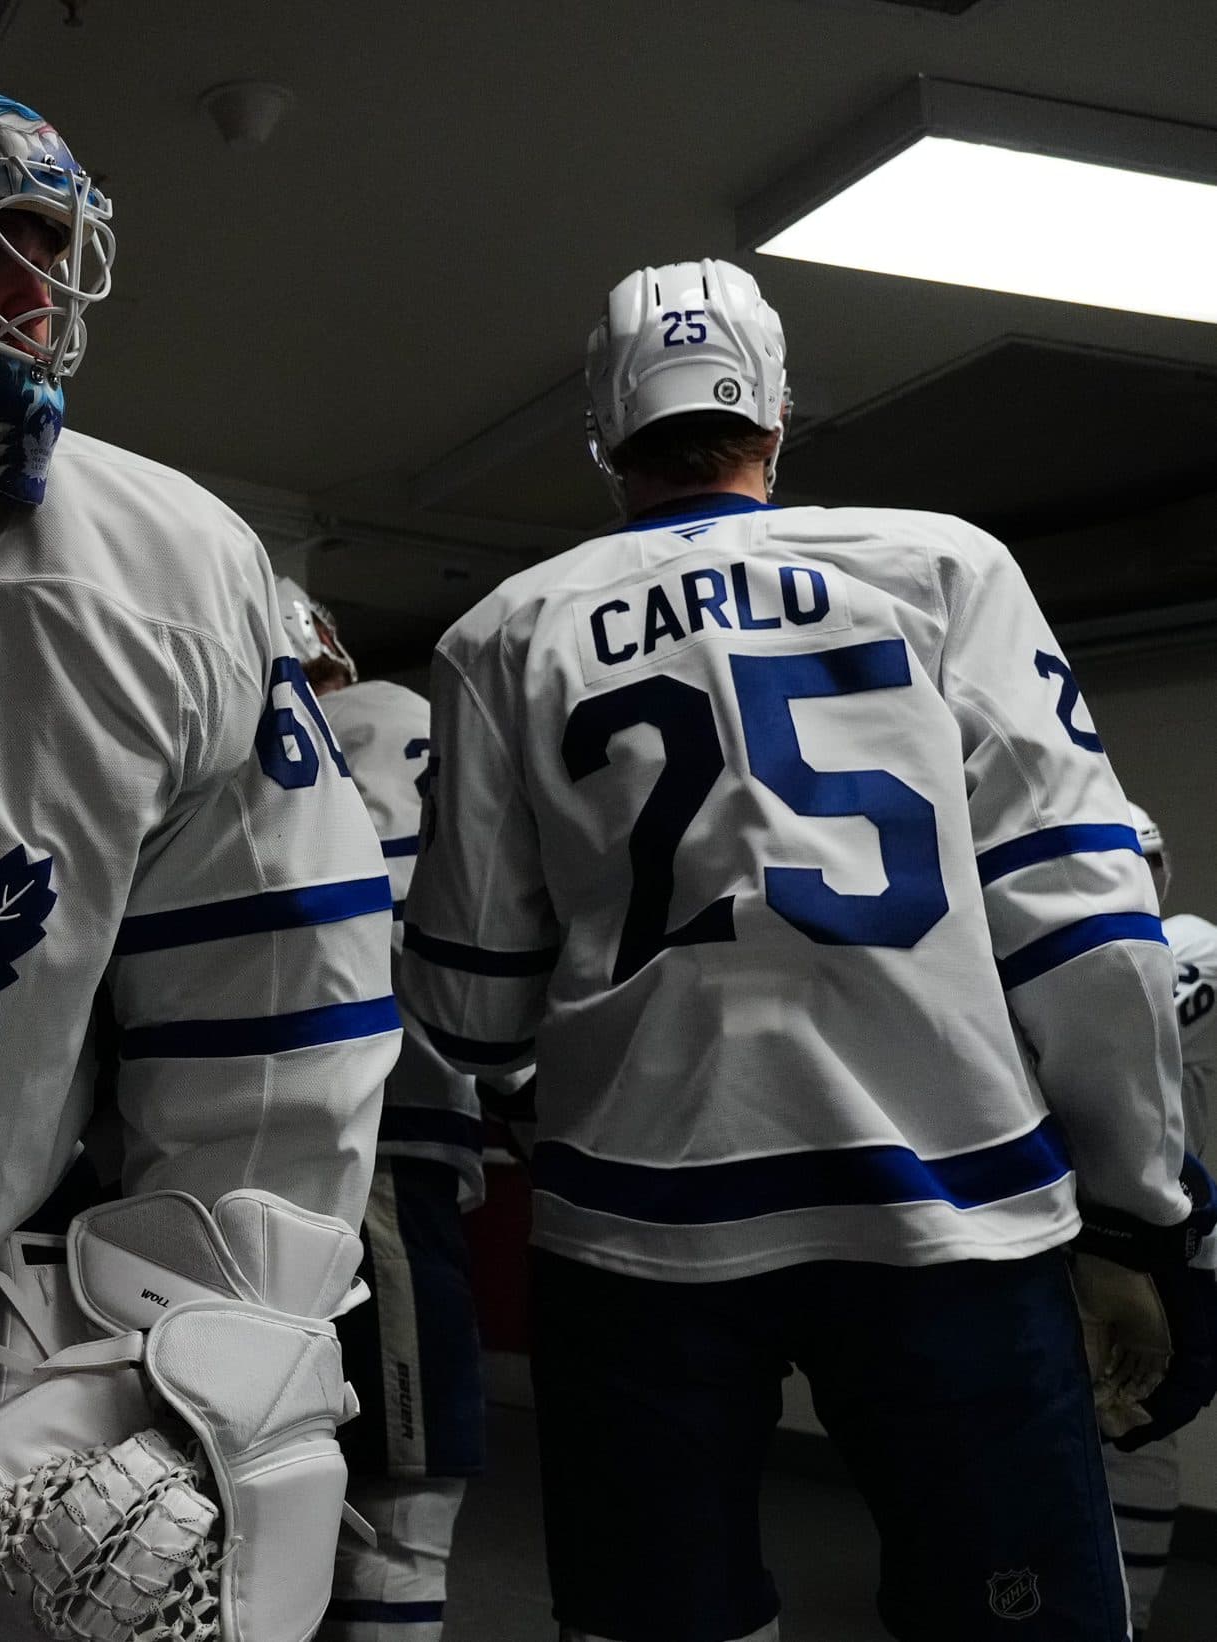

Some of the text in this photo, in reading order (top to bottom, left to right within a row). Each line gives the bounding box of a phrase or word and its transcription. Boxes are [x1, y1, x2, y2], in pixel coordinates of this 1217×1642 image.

[661, 309, 707, 347] 25
[590, 562, 830, 666] CARLO
[561, 638, 949, 985] 25
[141, 1288, 169, 1309] WOLL
[397, 1362, 414, 1440] BAUER
